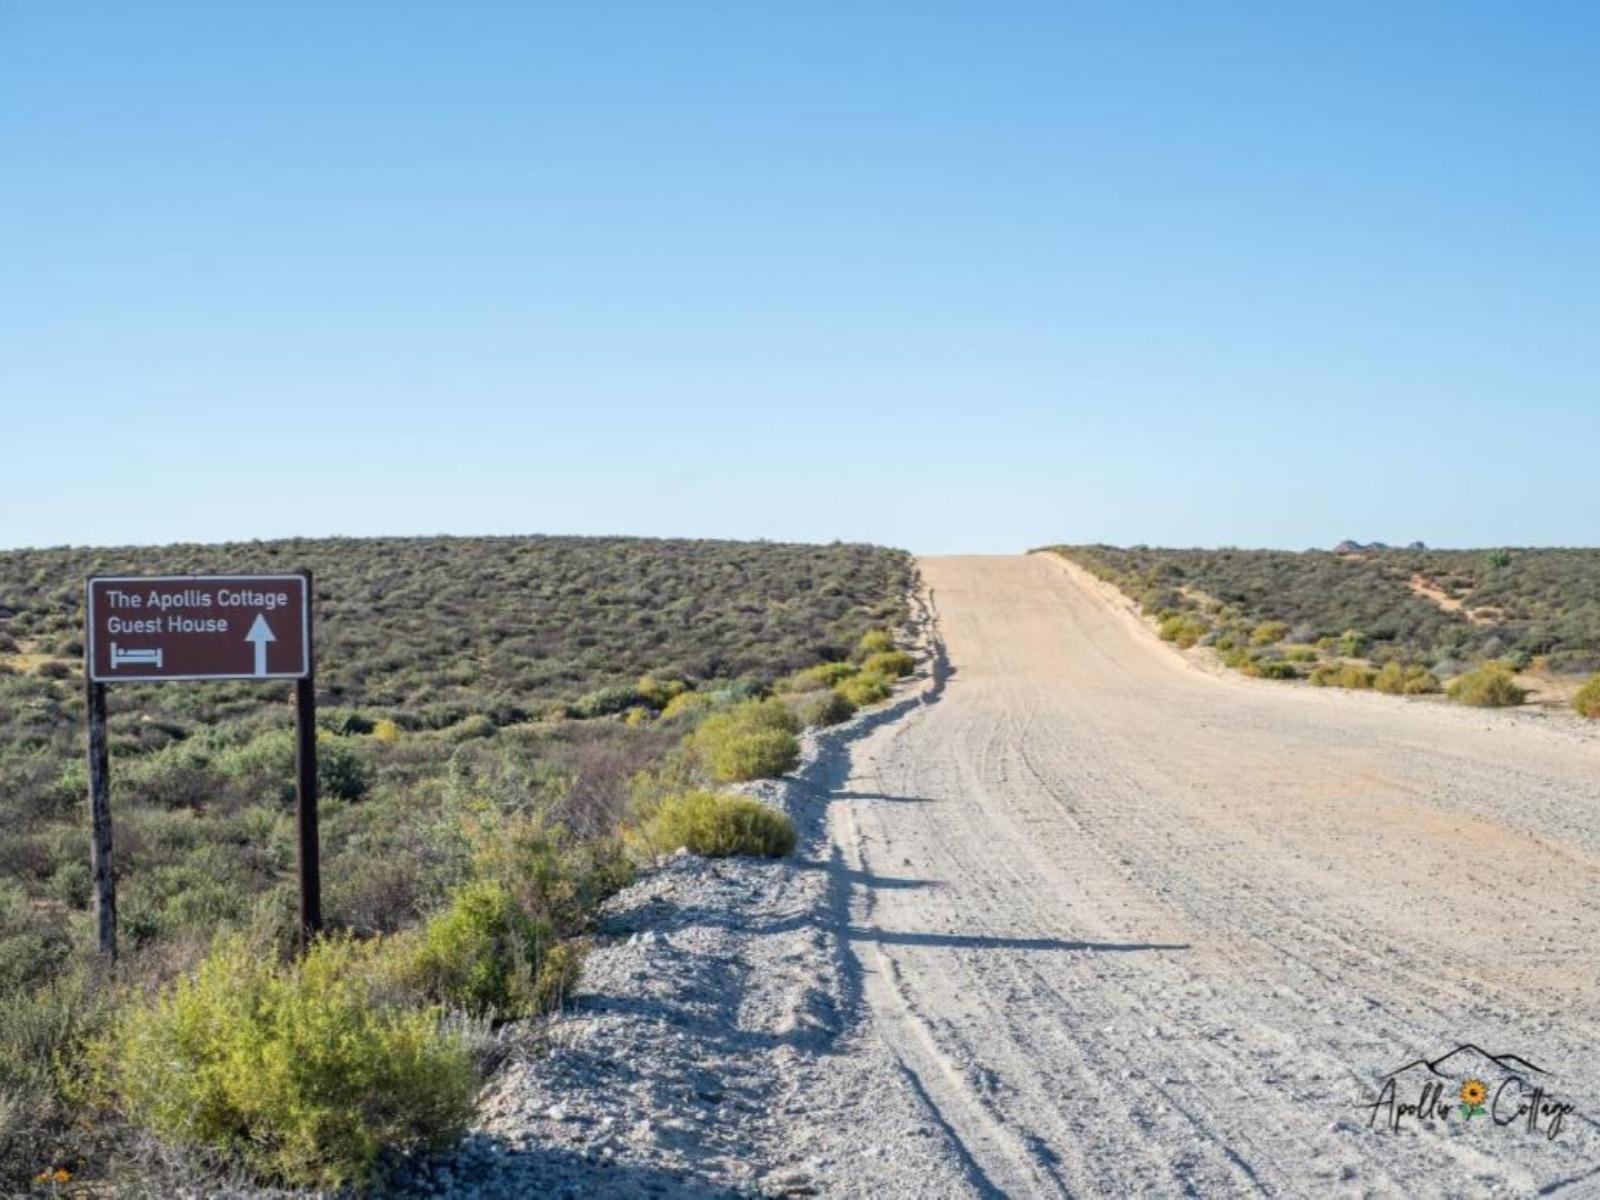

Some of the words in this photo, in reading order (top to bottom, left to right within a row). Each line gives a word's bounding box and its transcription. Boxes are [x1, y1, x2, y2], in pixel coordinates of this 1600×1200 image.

[106, 591, 141, 608] The
[147, 590, 212, 611] Apollis
[217, 589, 289, 610] Cottage
[107, 616, 163, 633] Guest
[168, 615, 229, 632] House
